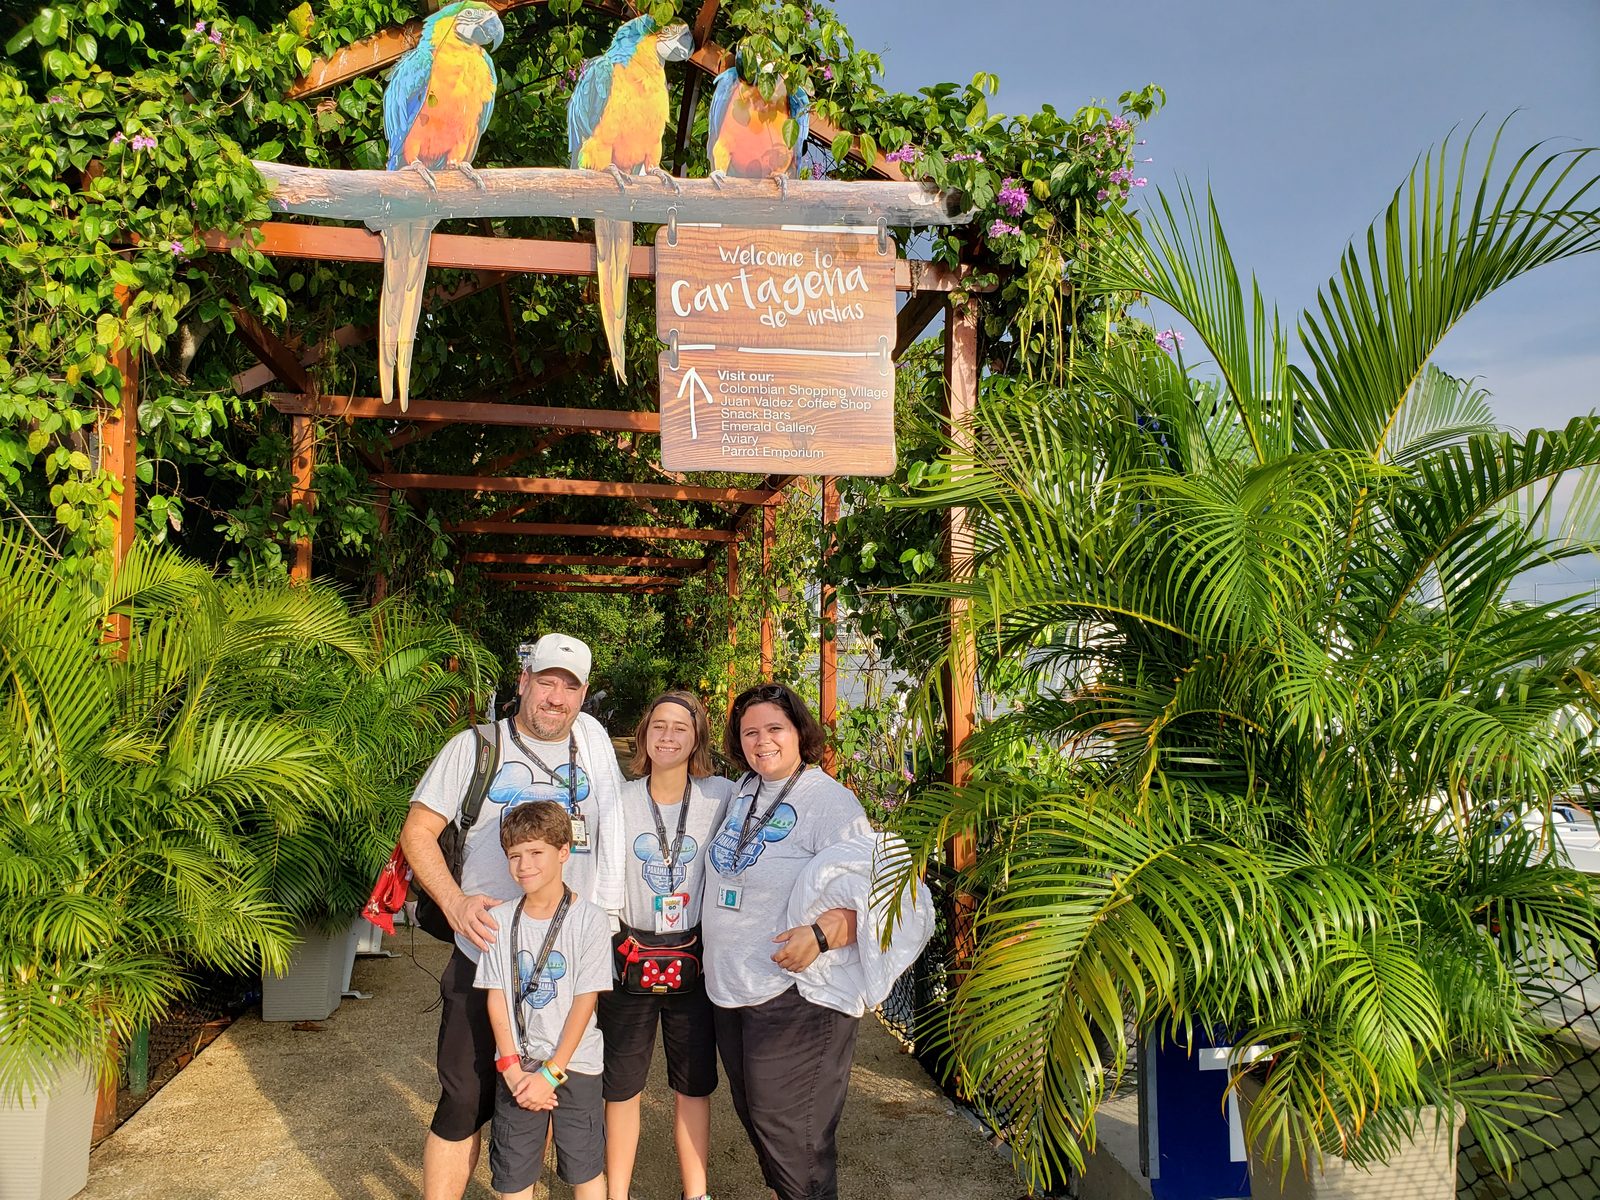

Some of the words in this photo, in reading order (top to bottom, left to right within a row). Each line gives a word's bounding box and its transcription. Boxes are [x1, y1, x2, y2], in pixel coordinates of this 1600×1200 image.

[718, 244, 804, 267] Welcome
[812, 247, 833, 269] to
[671, 265, 869, 317] Cartagena
[760, 305, 788, 328] de
[806, 299, 865, 326] indias
[717, 370, 746, 381] Visit
[749, 371, 775, 382] our:
[719, 383, 785, 395] Colombian
[789, 385, 847, 398] Shopping
[849, 386, 888, 399] Village
[721, 396, 750, 407] Juan
[754, 397, 793, 408] Valdez
[797, 398, 837, 409] Coffee
[840, 398, 872, 412] Shop
[721, 408, 759, 419] Snack
[763, 410, 791, 420] Bars
[721, 421, 772, 432] Emerald
[775, 422, 817, 435] Gallery
[721, 433, 759, 446] Aviary
[722, 446, 760, 457] Parrot
[763, 447, 824, 459] Emporium
